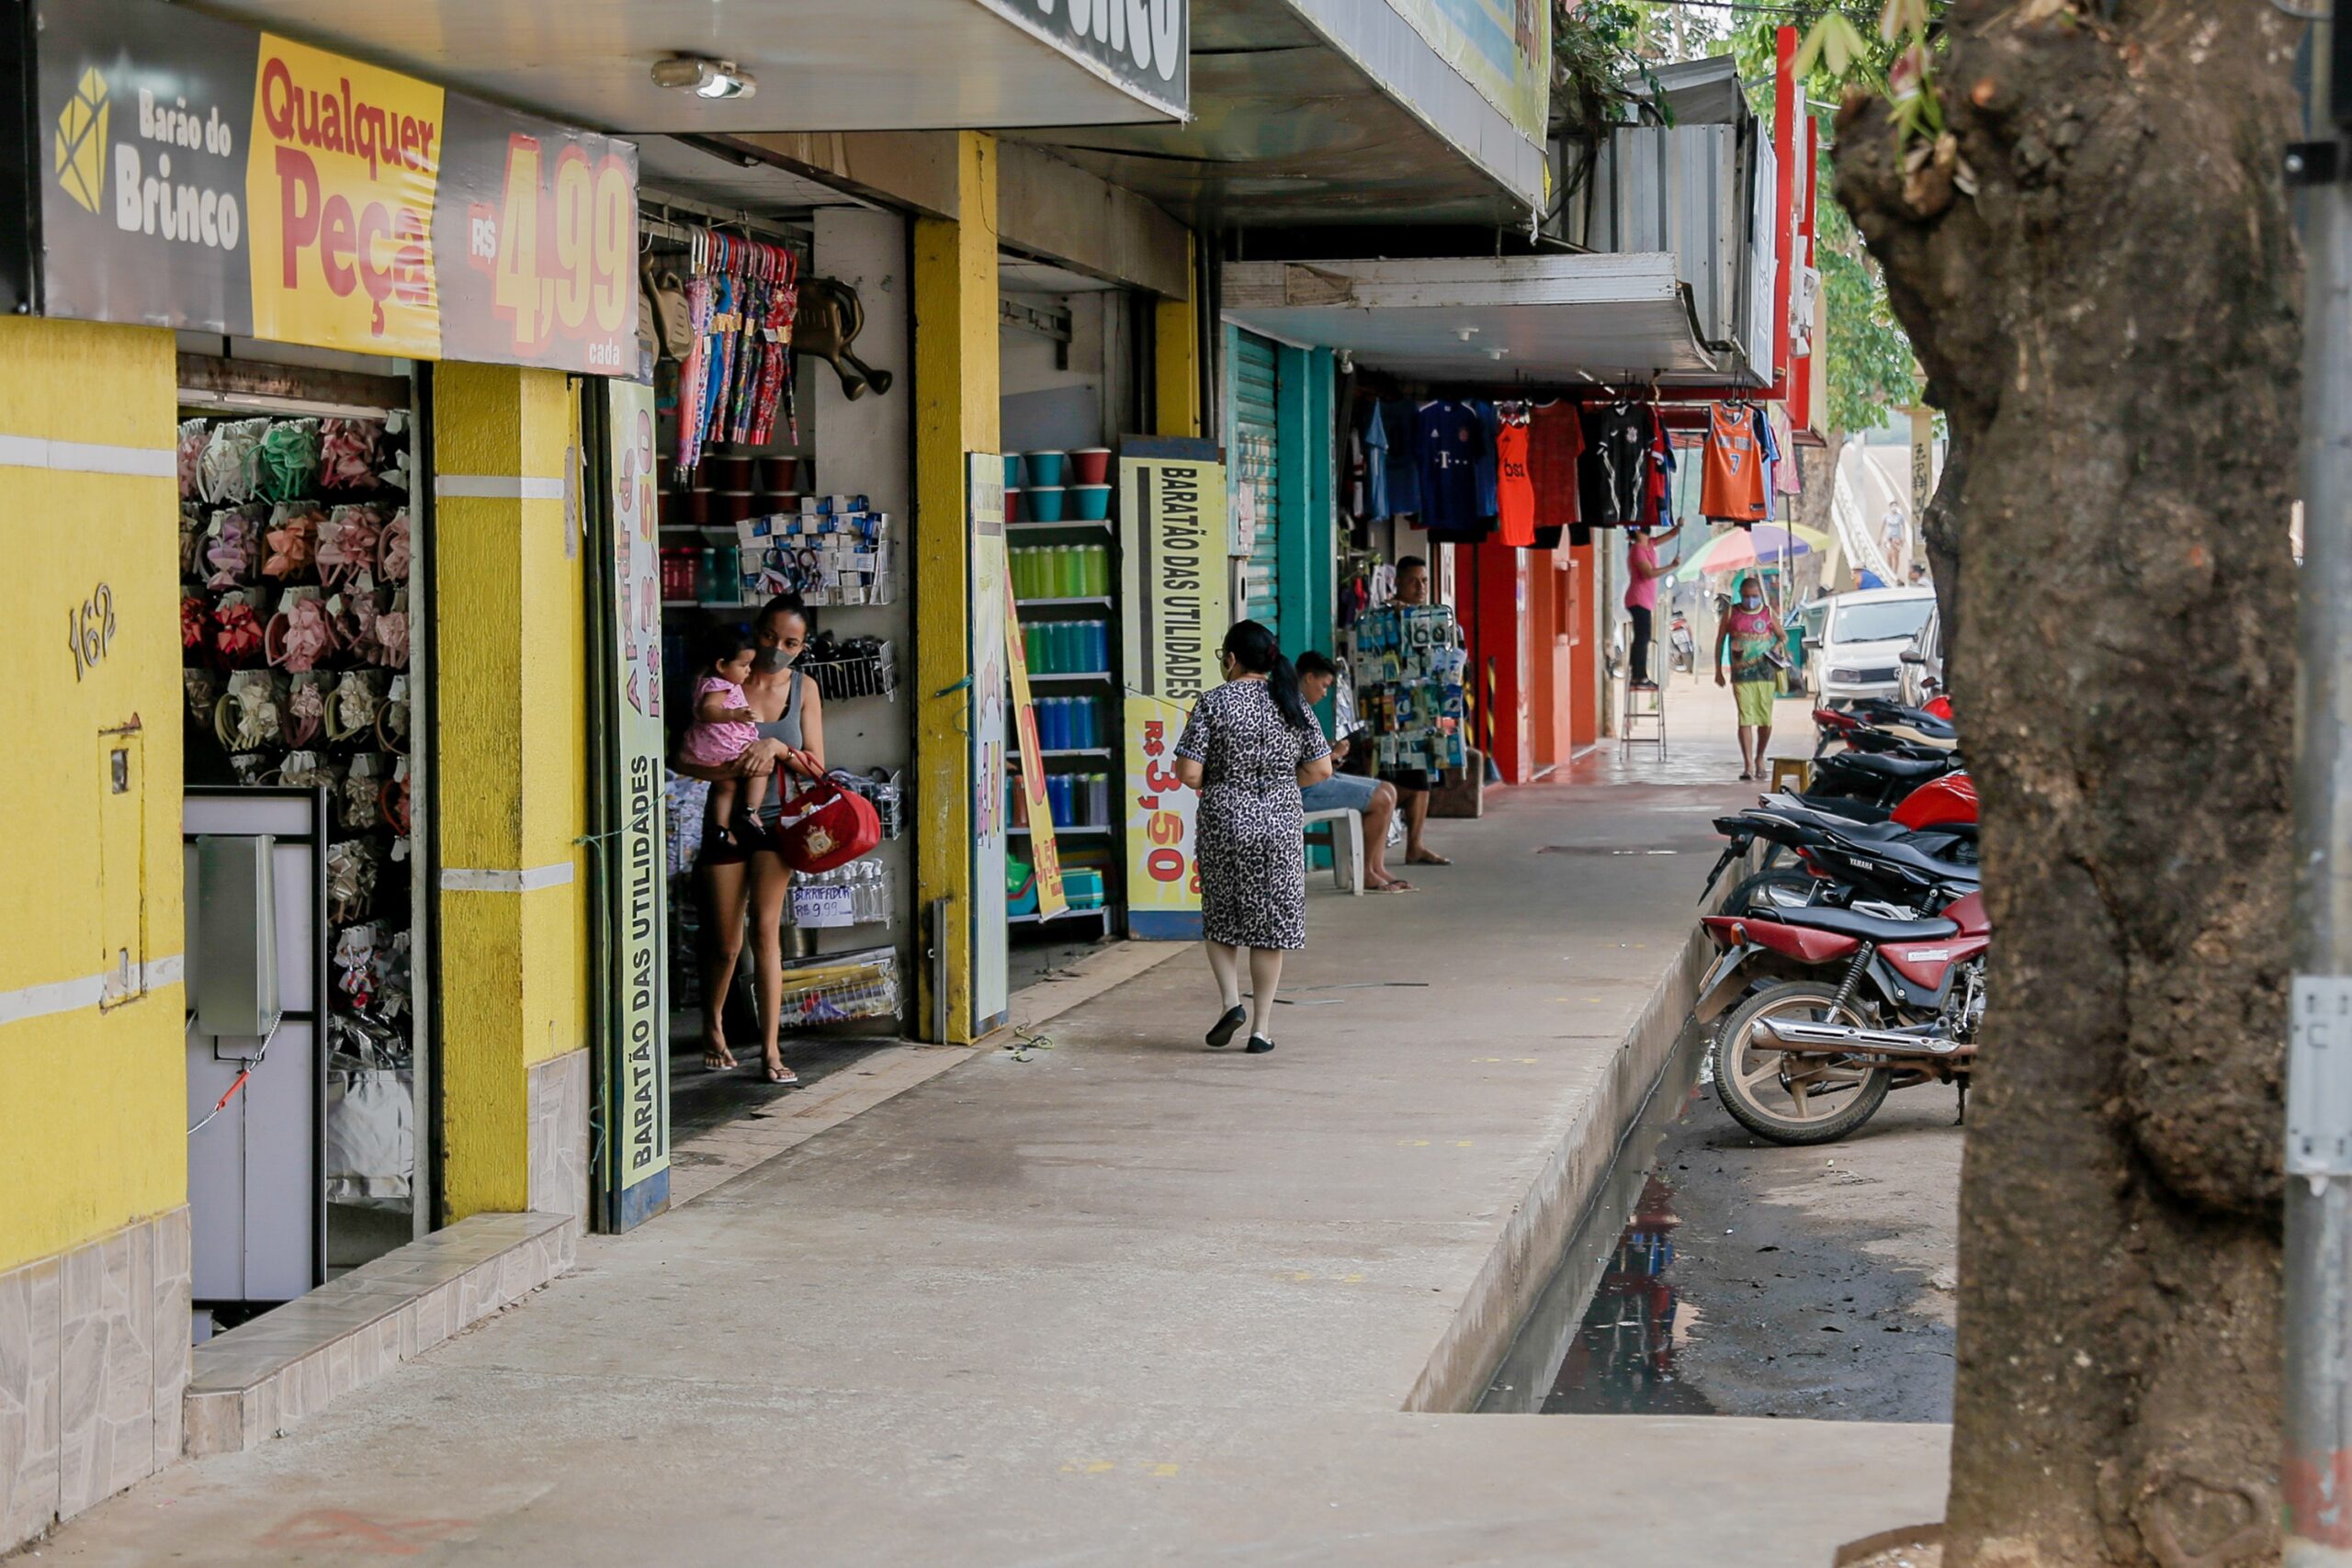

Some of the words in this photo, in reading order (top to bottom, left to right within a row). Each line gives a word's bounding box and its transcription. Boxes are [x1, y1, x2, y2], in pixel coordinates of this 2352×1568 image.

[139, 86, 201, 151] Barão
[206, 106, 232, 157] do
[261, 57, 434, 181] Qualquer
[115, 143, 240, 251] Brinco
[276, 146, 432, 339] Peça
[471, 214, 496, 265] R$
[493, 142, 632, 345] 4,99
[589, 338, 620, 367] cada
[1160, 467, 1207, 549] BARATÃO
[1729, 453, 1741, 476] 7
[637, 409, 659, 637] 3,50
[1162, 555, 1200, 592] DAS
[69, 581, 116, 683] 162
[616, 520, 638, 660] partir
[627, 667, 641, 716] A
[647, 644, 660, 718] R$
[1163, 594, 1202, 700] UTILIDADES
[1142, 721, 1165, 757] R$
[631, 754, 650, 941] UTILIDADES
[1136, 759, 1184, 883] 3,50
[1849, 858, 1873, 871] YAMAHA
[632, 949, 650, 1012] DAS
[628, 1020, 650, 1170] BARATÃO
